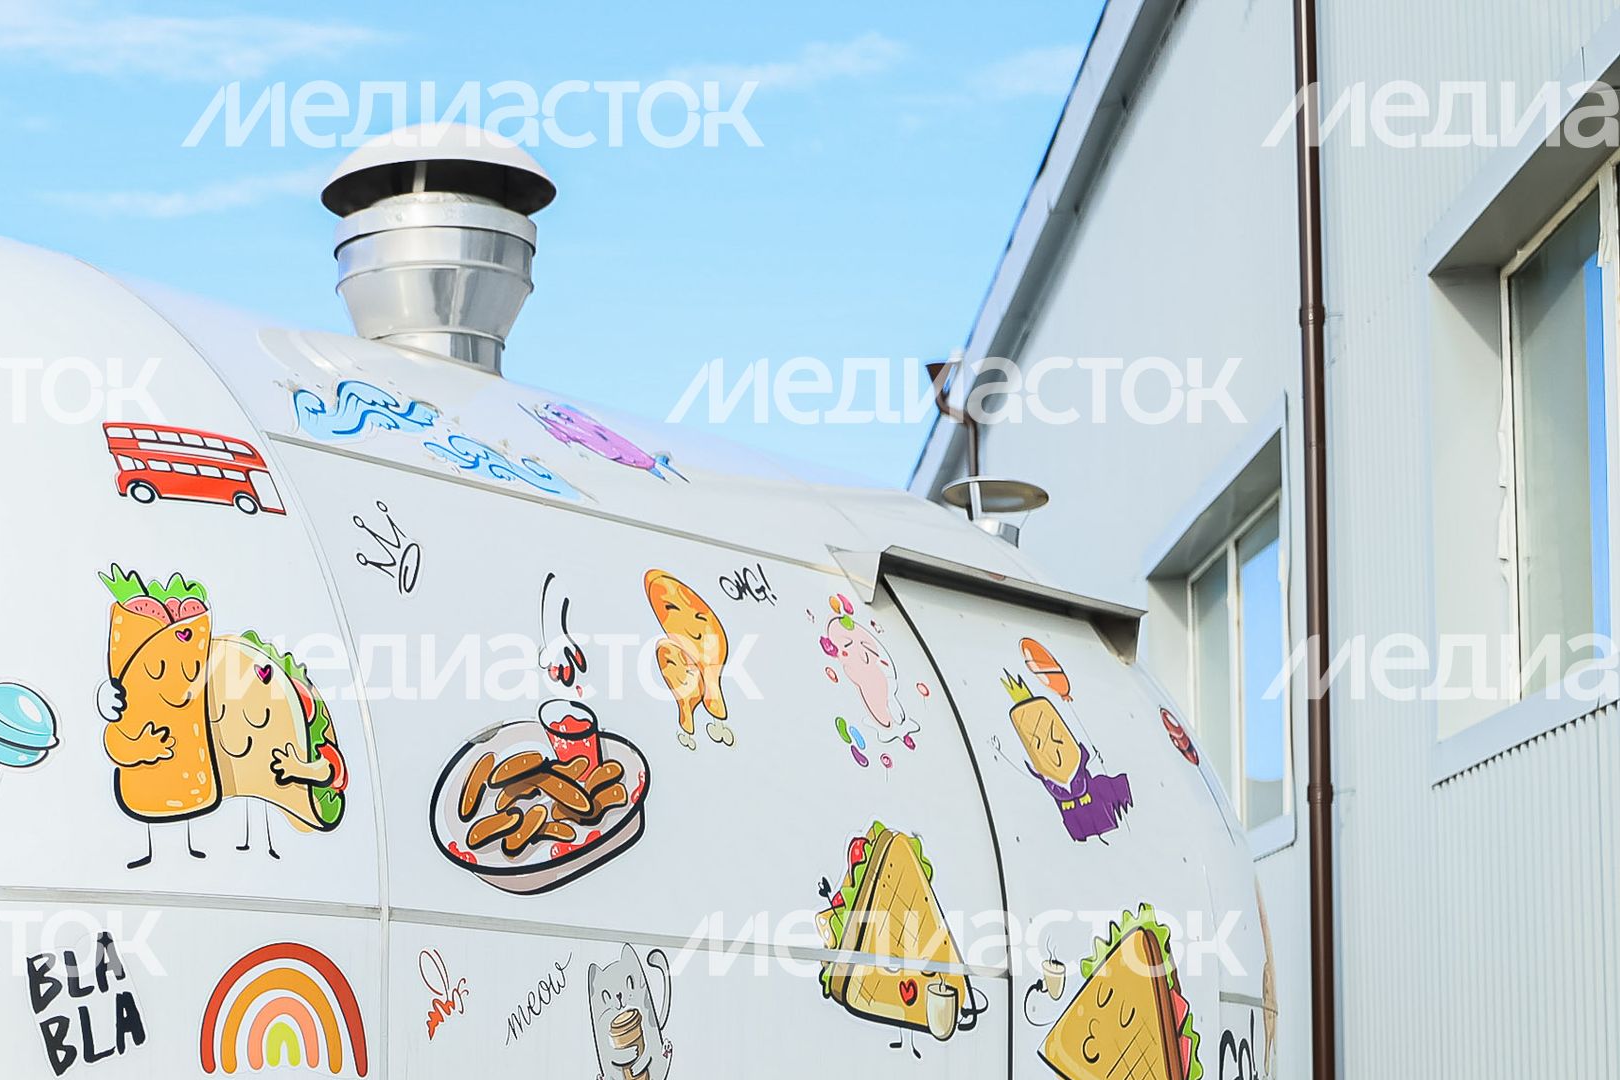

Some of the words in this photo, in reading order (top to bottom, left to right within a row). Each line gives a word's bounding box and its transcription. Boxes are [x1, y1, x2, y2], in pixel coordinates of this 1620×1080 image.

[719, 563, 777, 606] OMG!
[26, 931, 126, 1015] BLA
[505, 951, 573, 1046] meow
[38, 991, 146, 1077] BLA
